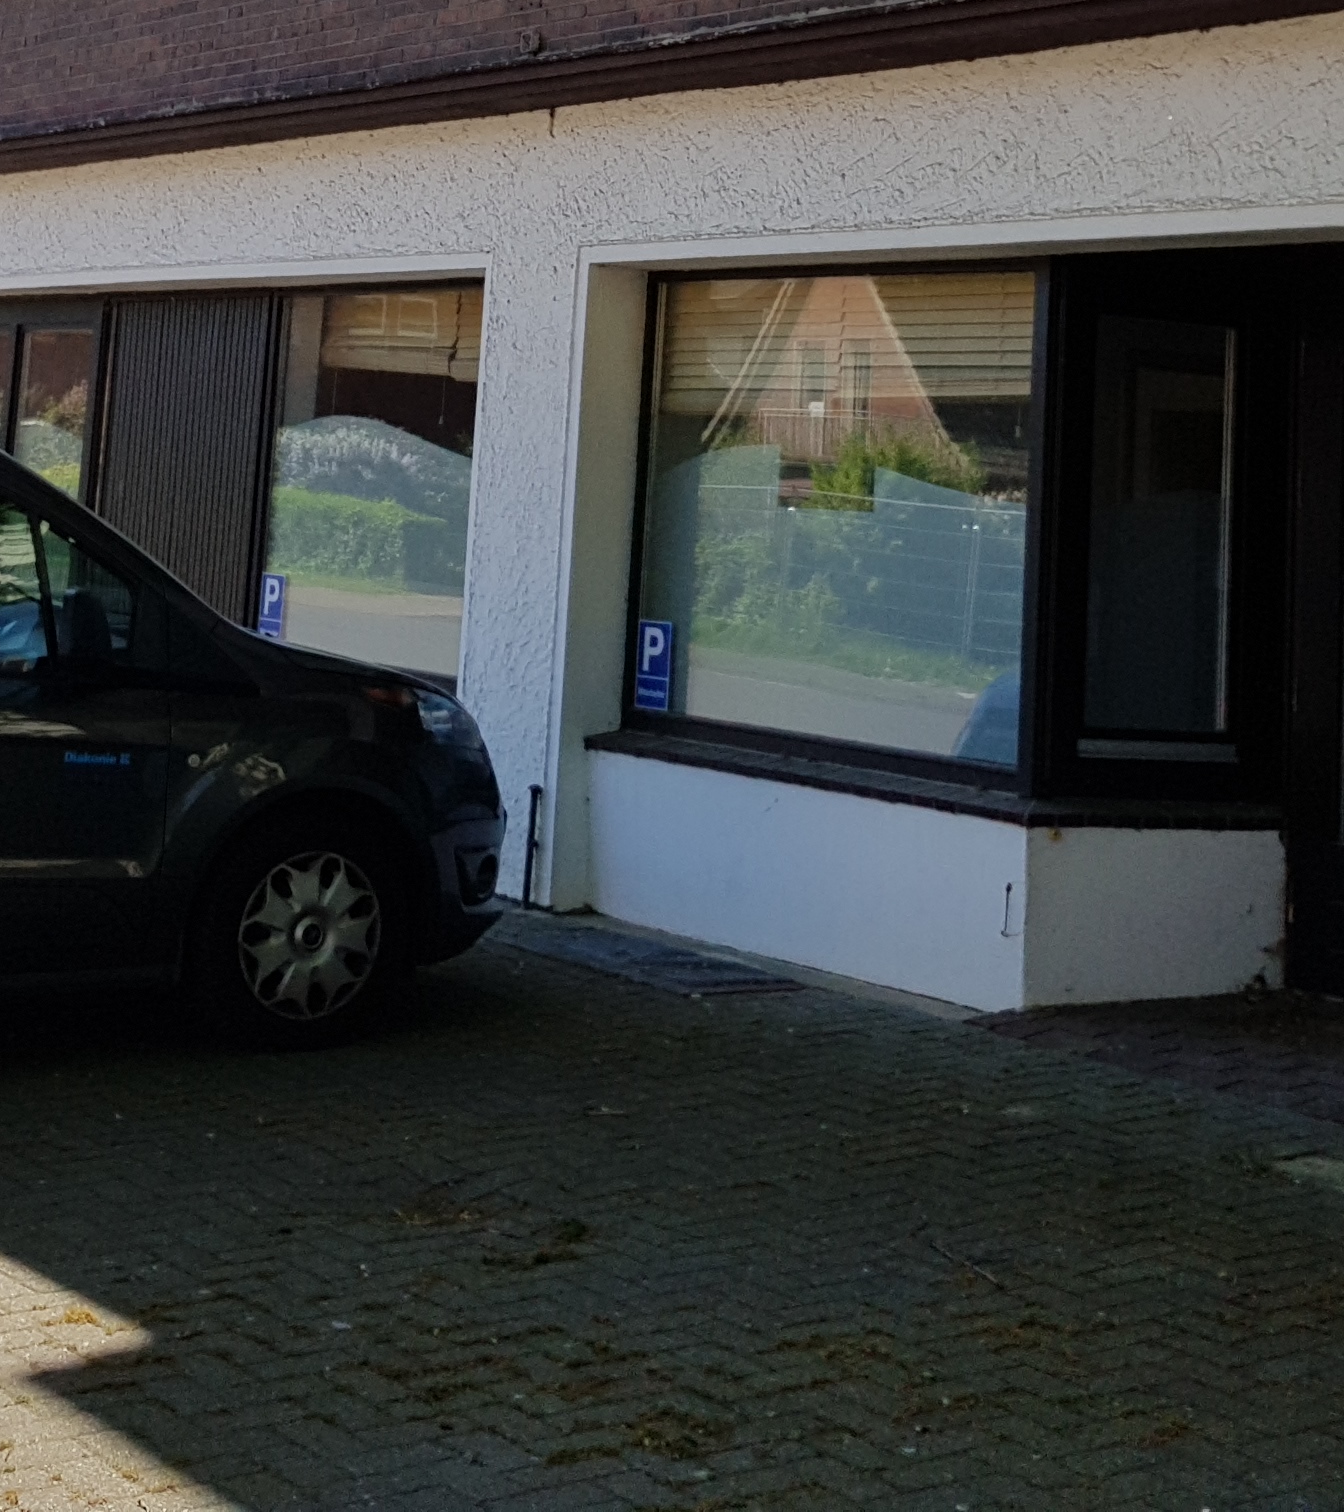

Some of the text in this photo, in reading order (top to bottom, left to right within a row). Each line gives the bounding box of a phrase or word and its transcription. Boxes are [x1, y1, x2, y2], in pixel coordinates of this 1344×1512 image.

[263, 577, 280, 616] P
[642, 626, 665, 672] P
[64, 751, 117, 765] Diakonie
